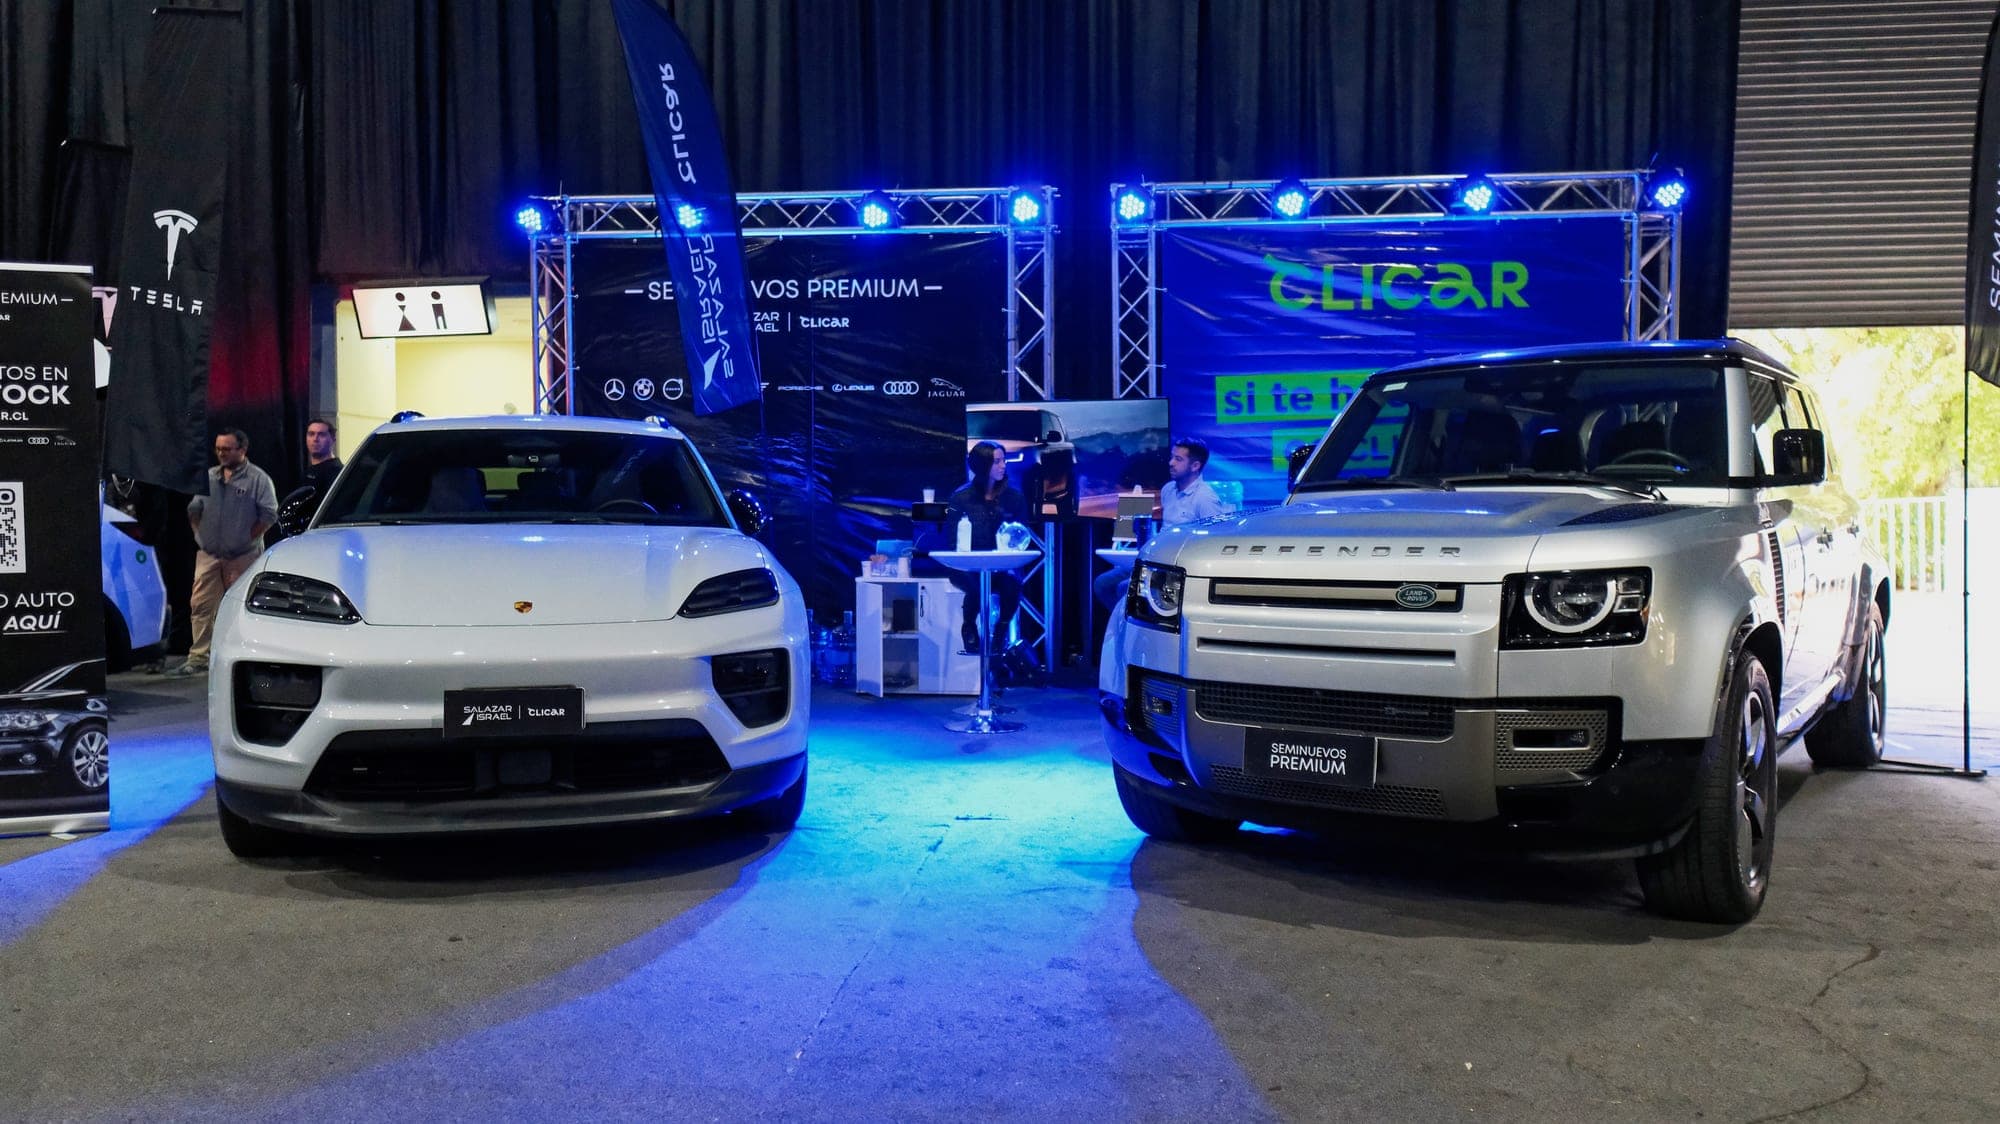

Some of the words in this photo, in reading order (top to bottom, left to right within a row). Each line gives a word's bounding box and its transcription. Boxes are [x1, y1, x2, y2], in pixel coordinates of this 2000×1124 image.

[807, 278, 920, 298] PREMIUM
[130, 286, 203, 315] TESLA
[42, 366, 68, 381] EN
[0, 384, 71, 405] OCK
[1224, 381, 1257, 416] si
[1271, 382, 1314, 414] te
[1220, 544, 1461, 558] DEFENDER
[14, 592, 75, 608] AUTO
[2, 610, 62, 631] AQUÍ
[463, 705, 512, 714] SALAZAR
[476, 712, 512, 721] ISRAEL
[1271, 742, 1347, 760] SEMINUEVOS
[1269, 754, 1346, 776] PREMIUM
